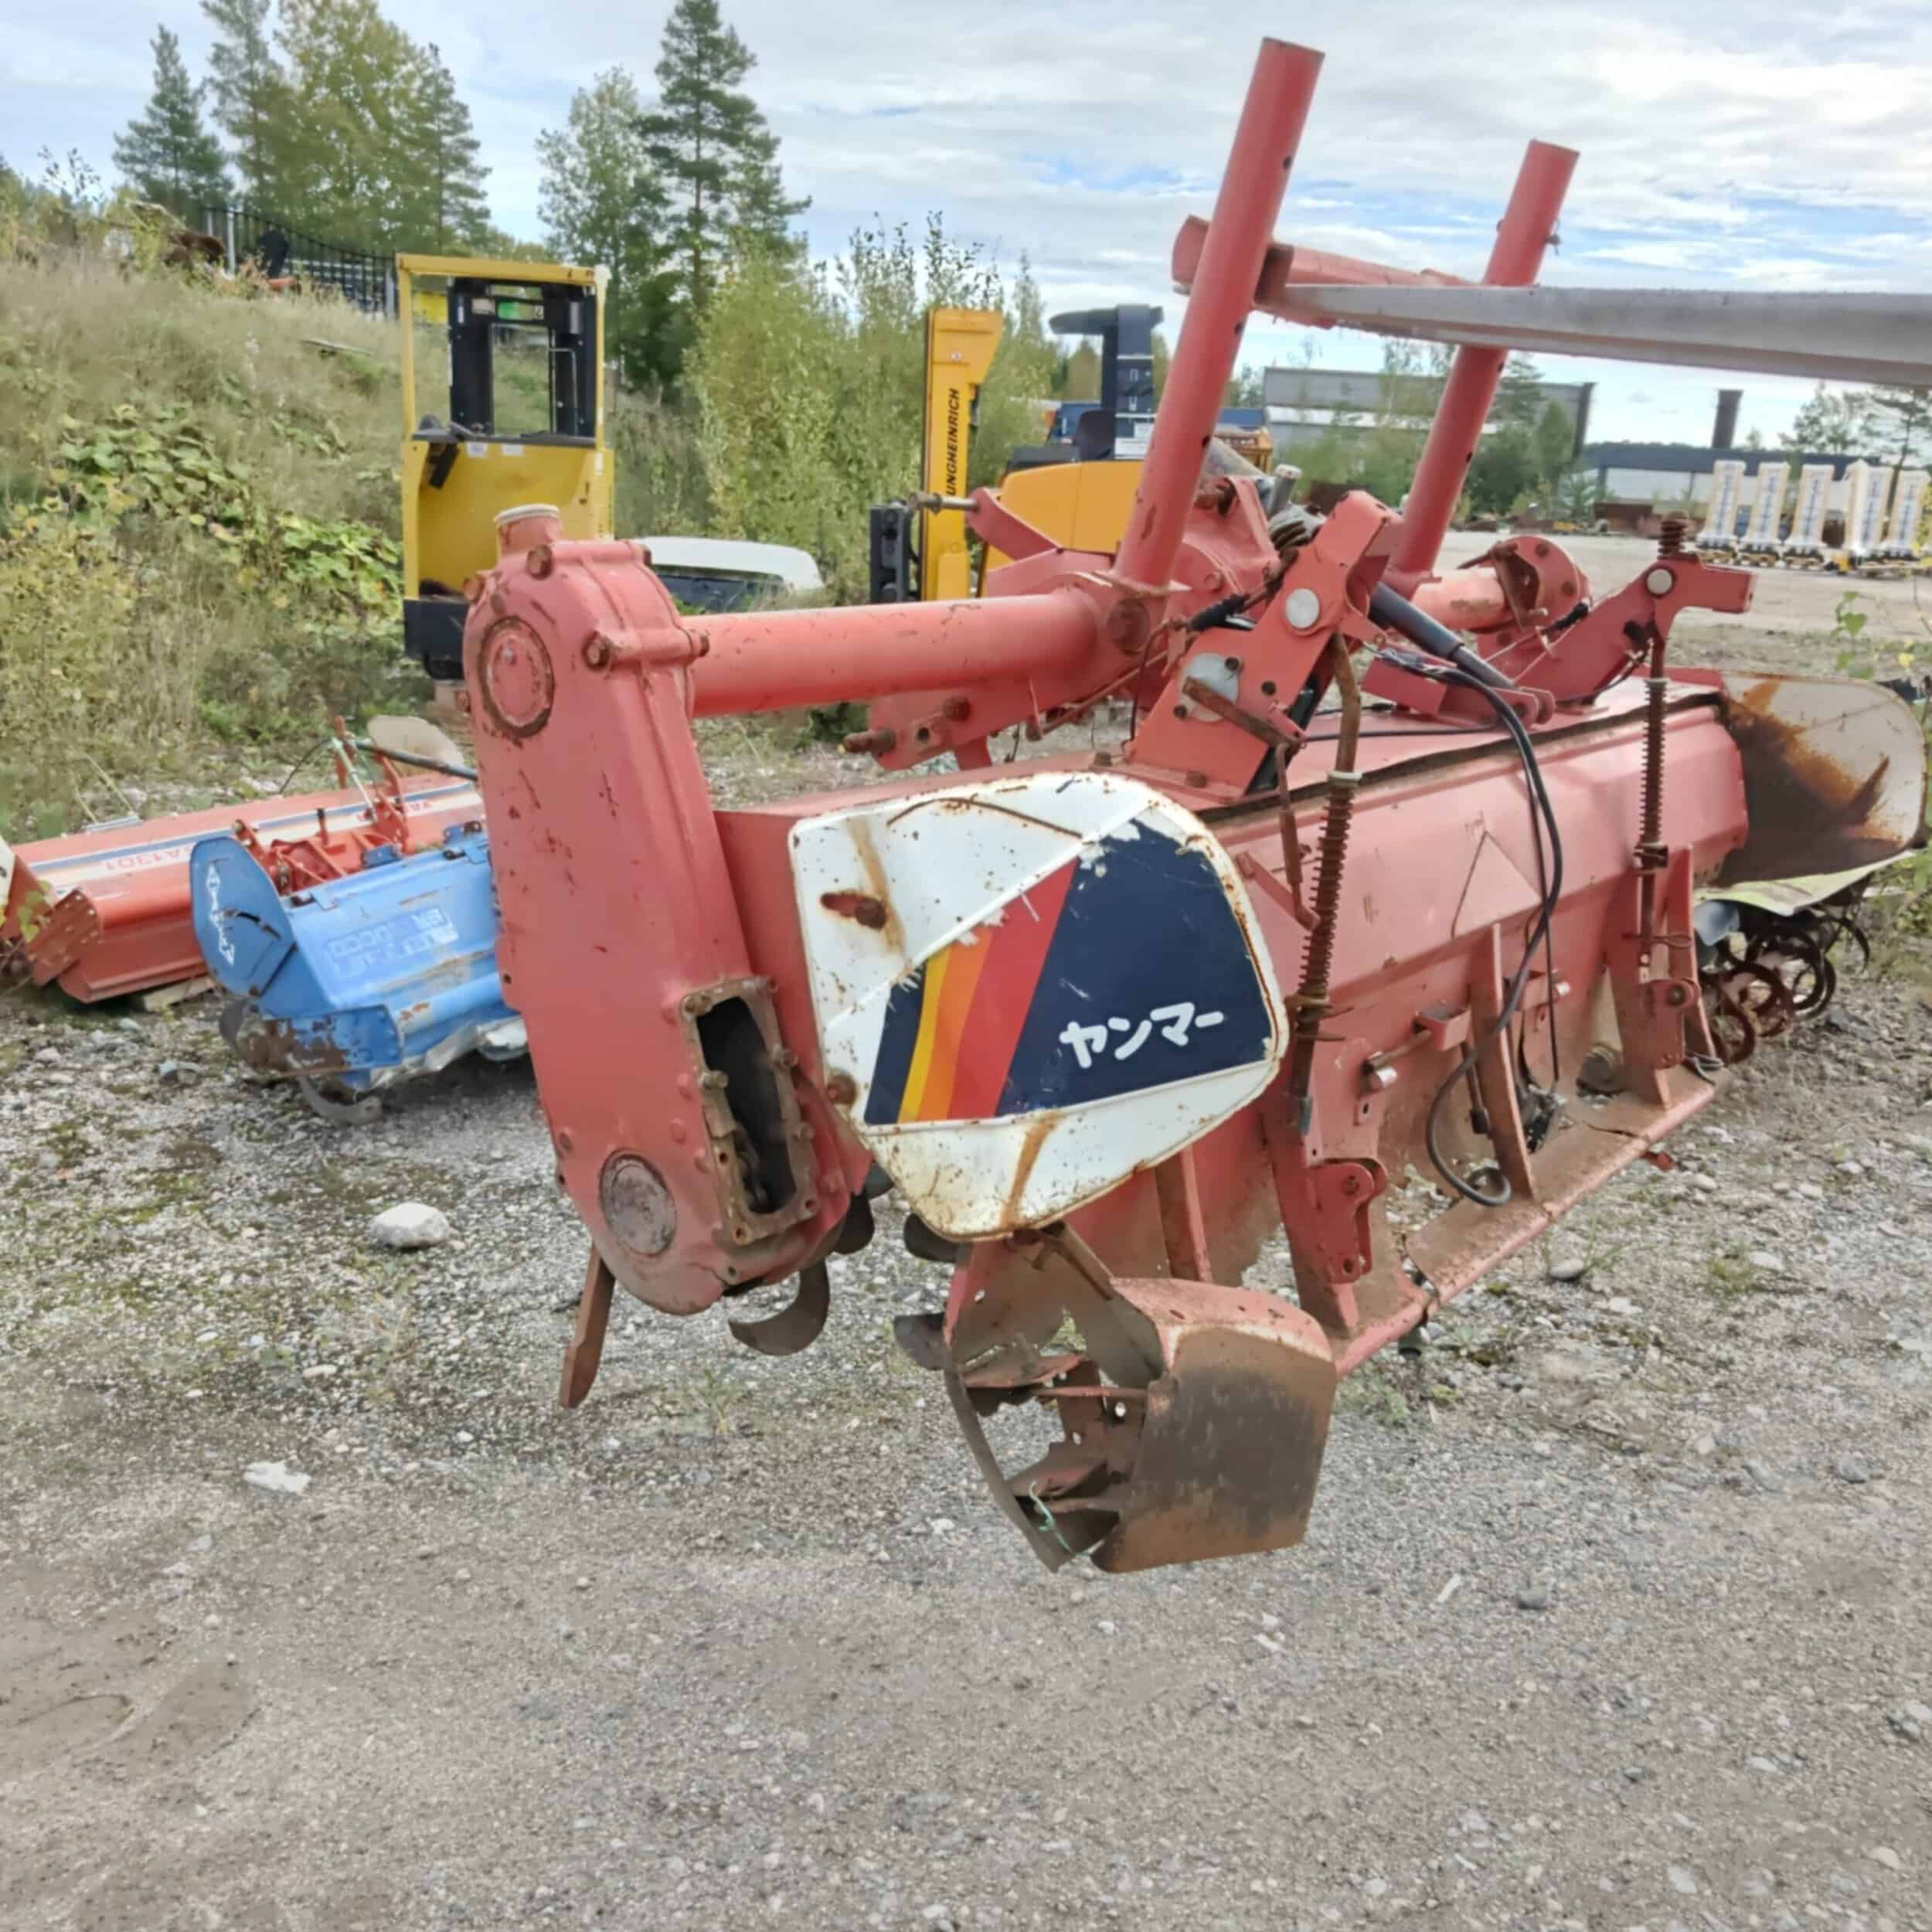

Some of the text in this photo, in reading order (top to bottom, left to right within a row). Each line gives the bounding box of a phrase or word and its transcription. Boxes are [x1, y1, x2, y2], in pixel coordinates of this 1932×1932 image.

[945, 387, 960, 496] UNGHEINRICH
[1059, 1002, 1224, 1069] ヤンマー
